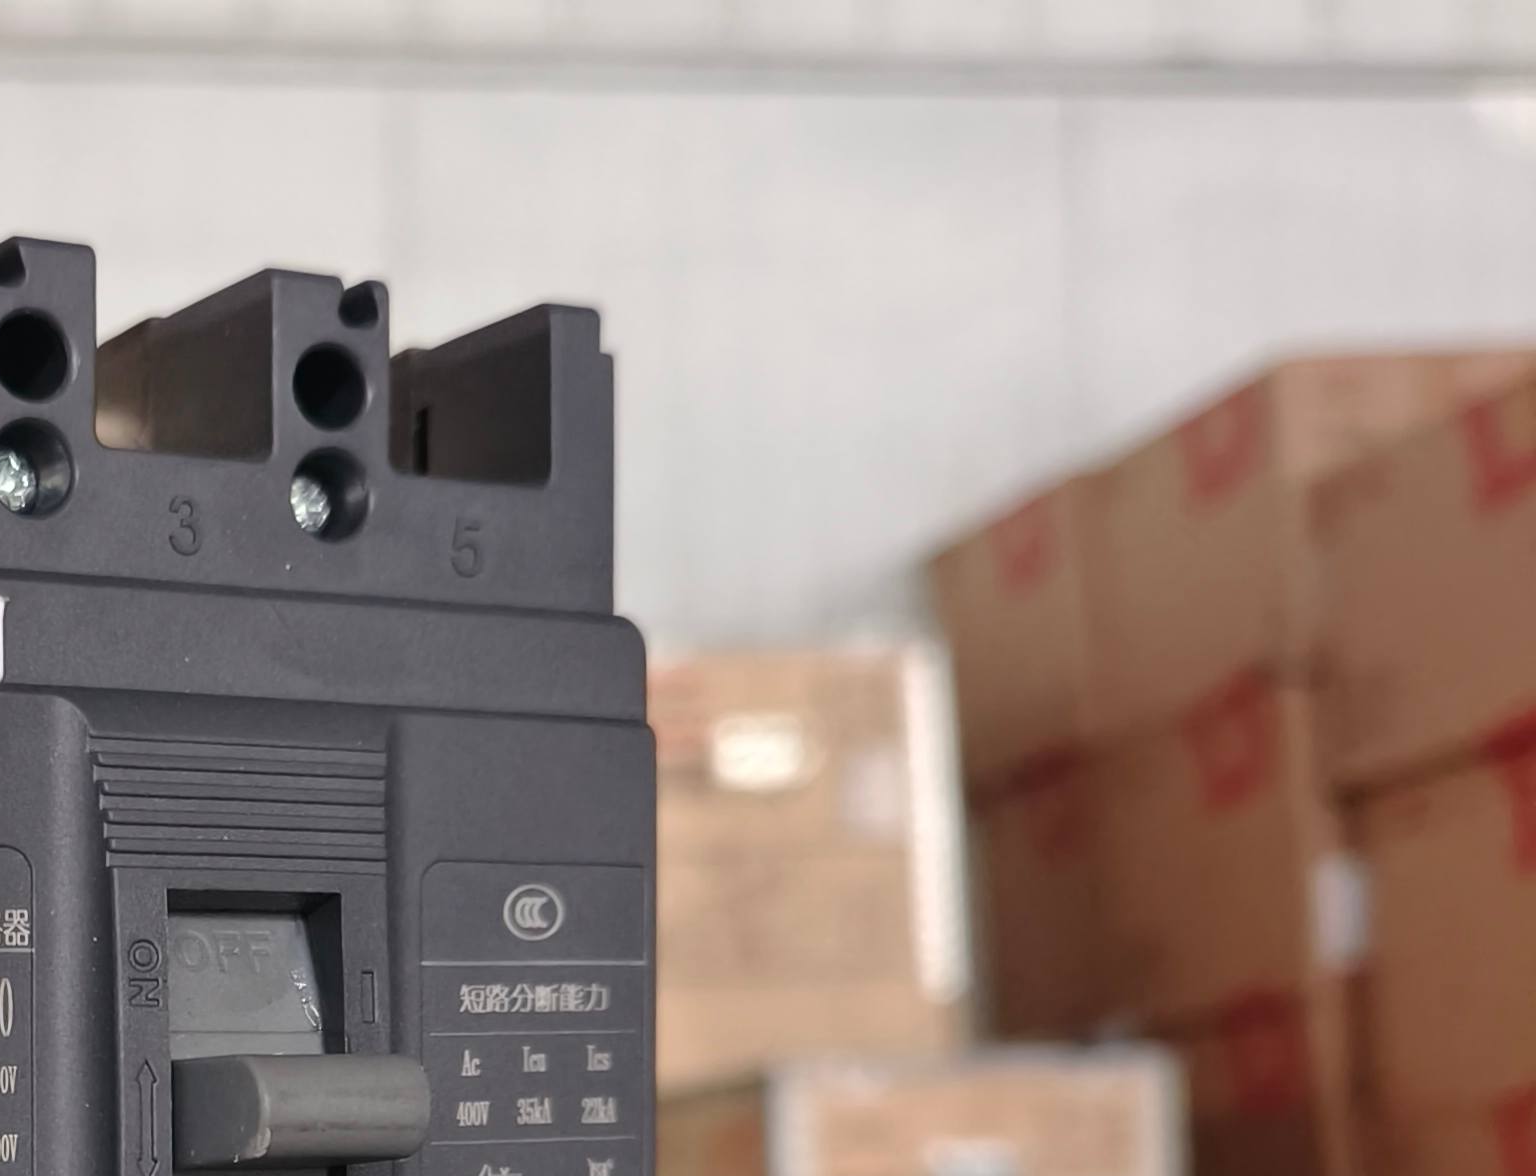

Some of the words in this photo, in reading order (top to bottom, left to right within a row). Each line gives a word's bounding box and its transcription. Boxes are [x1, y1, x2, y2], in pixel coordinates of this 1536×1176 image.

[167, 495, 201, 556] 3
[449, 519, 482, 578] 5
[177, 930, 272, 973] OFF
[128, 939, 161, 1008] ON
[459, 983, 609, 1013] 短路分断能力
[461, 1049, 481, 1076] Ac
[456, 1101, 491, 1127] 400V
